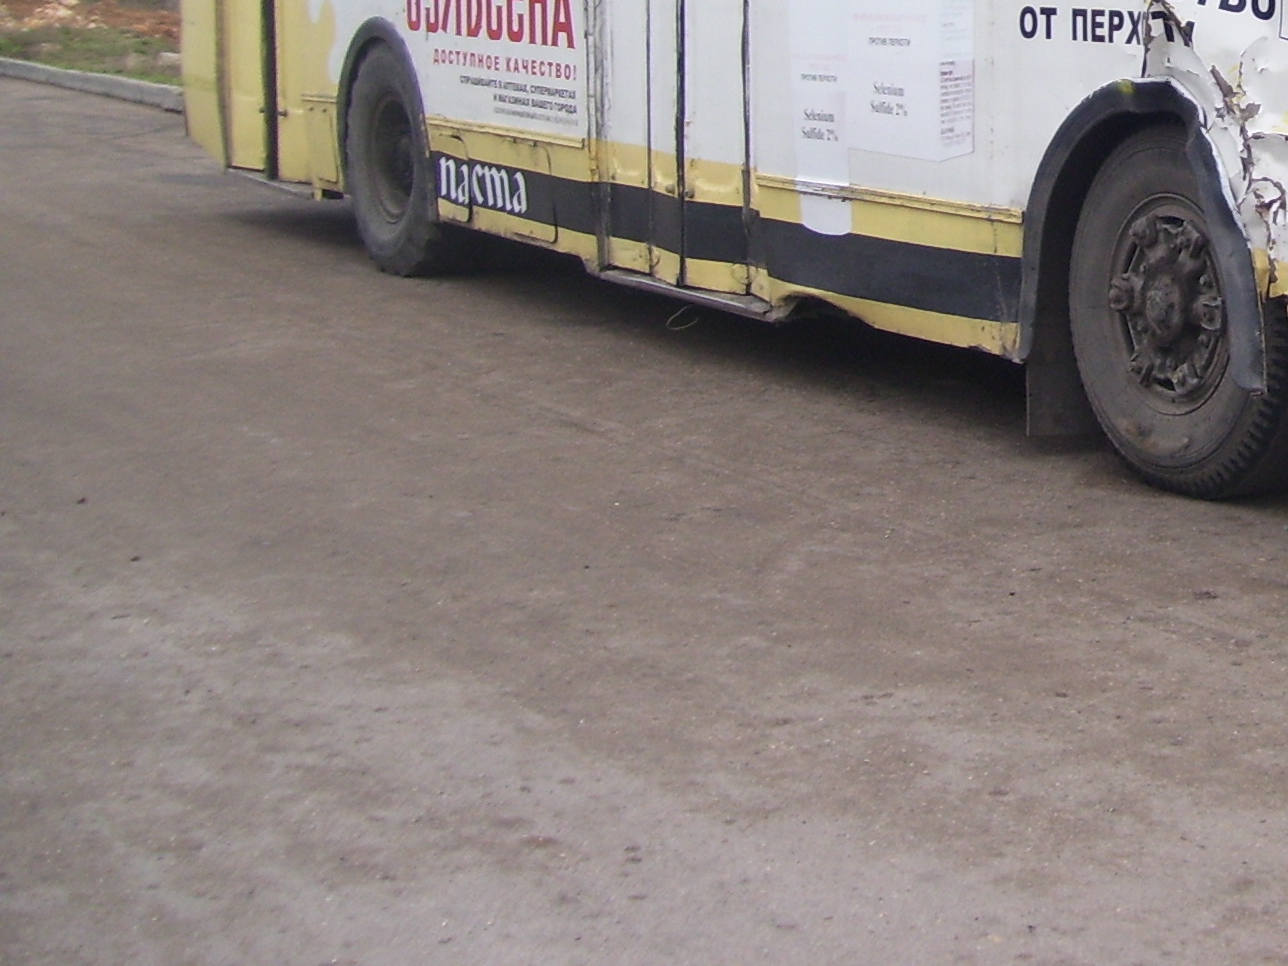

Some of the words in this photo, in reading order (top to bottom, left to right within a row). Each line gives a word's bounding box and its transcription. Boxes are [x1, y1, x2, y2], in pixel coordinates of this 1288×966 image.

[1019, 6, 1057, 40] ОТ
[1071, 8, 1195, 47] ПЕРХТИ
[433, 48, 500, 71] ДОСТУПНОЕ
[505, 57, 577, 81] КАЧЕСТВО!
